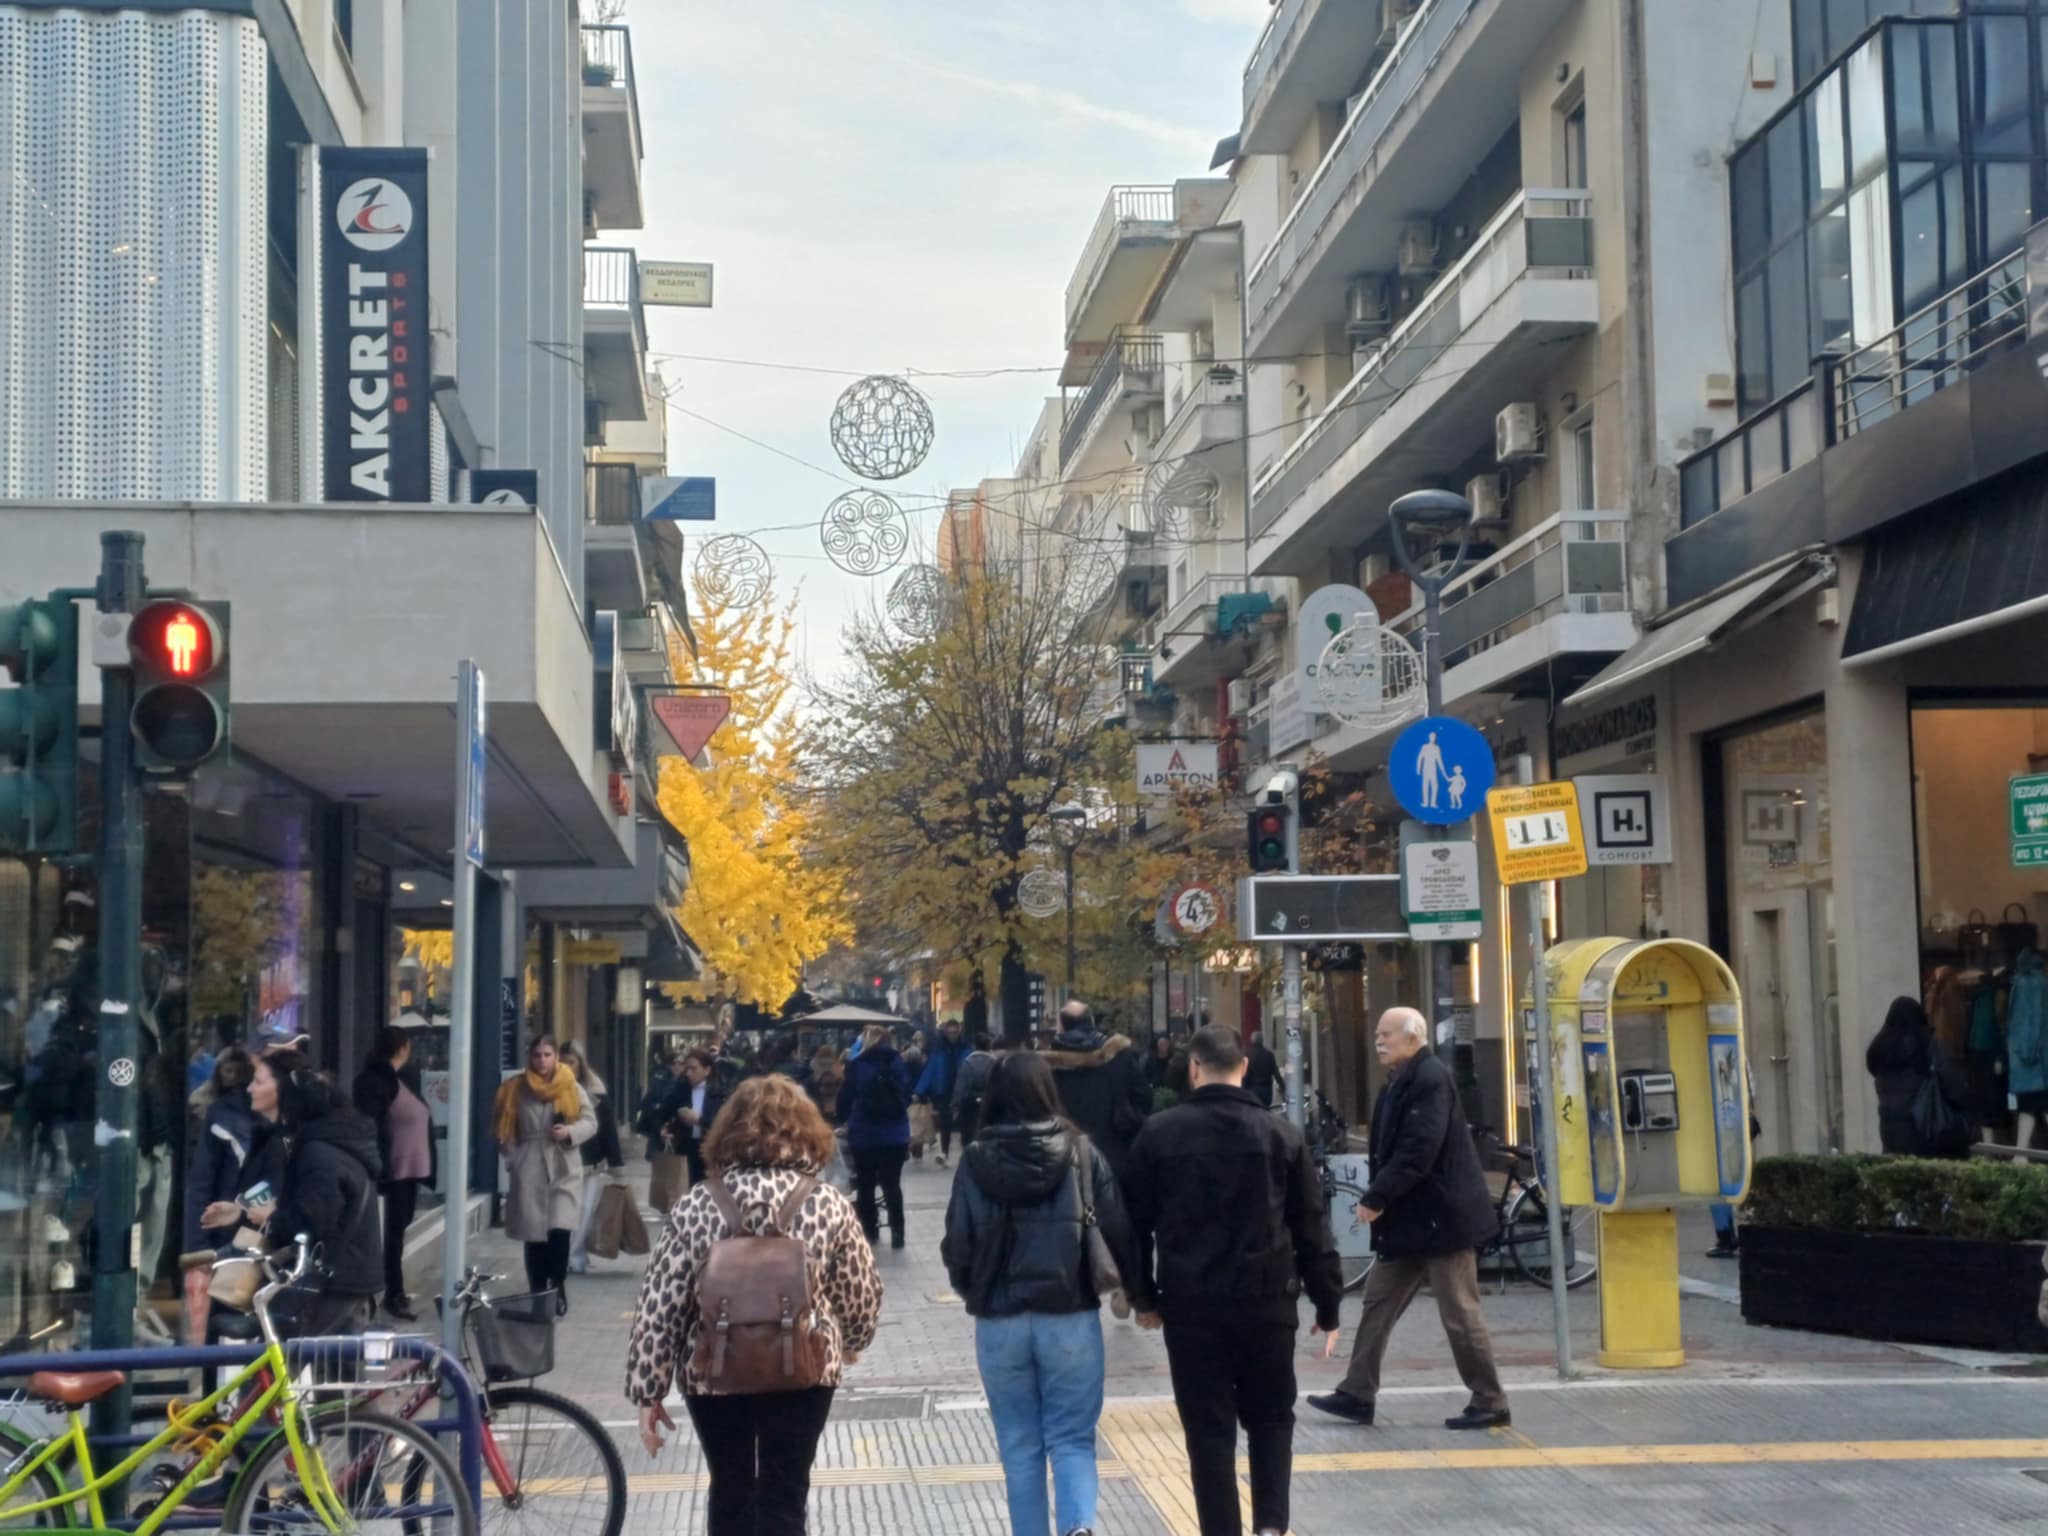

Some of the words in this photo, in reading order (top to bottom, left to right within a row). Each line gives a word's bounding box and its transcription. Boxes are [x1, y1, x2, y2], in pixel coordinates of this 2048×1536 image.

[391, 271, 409, 414] SPORTS
[663, 699, 721, 713] Unicorn
[1599, 851, 1653, 862] COMFORT
